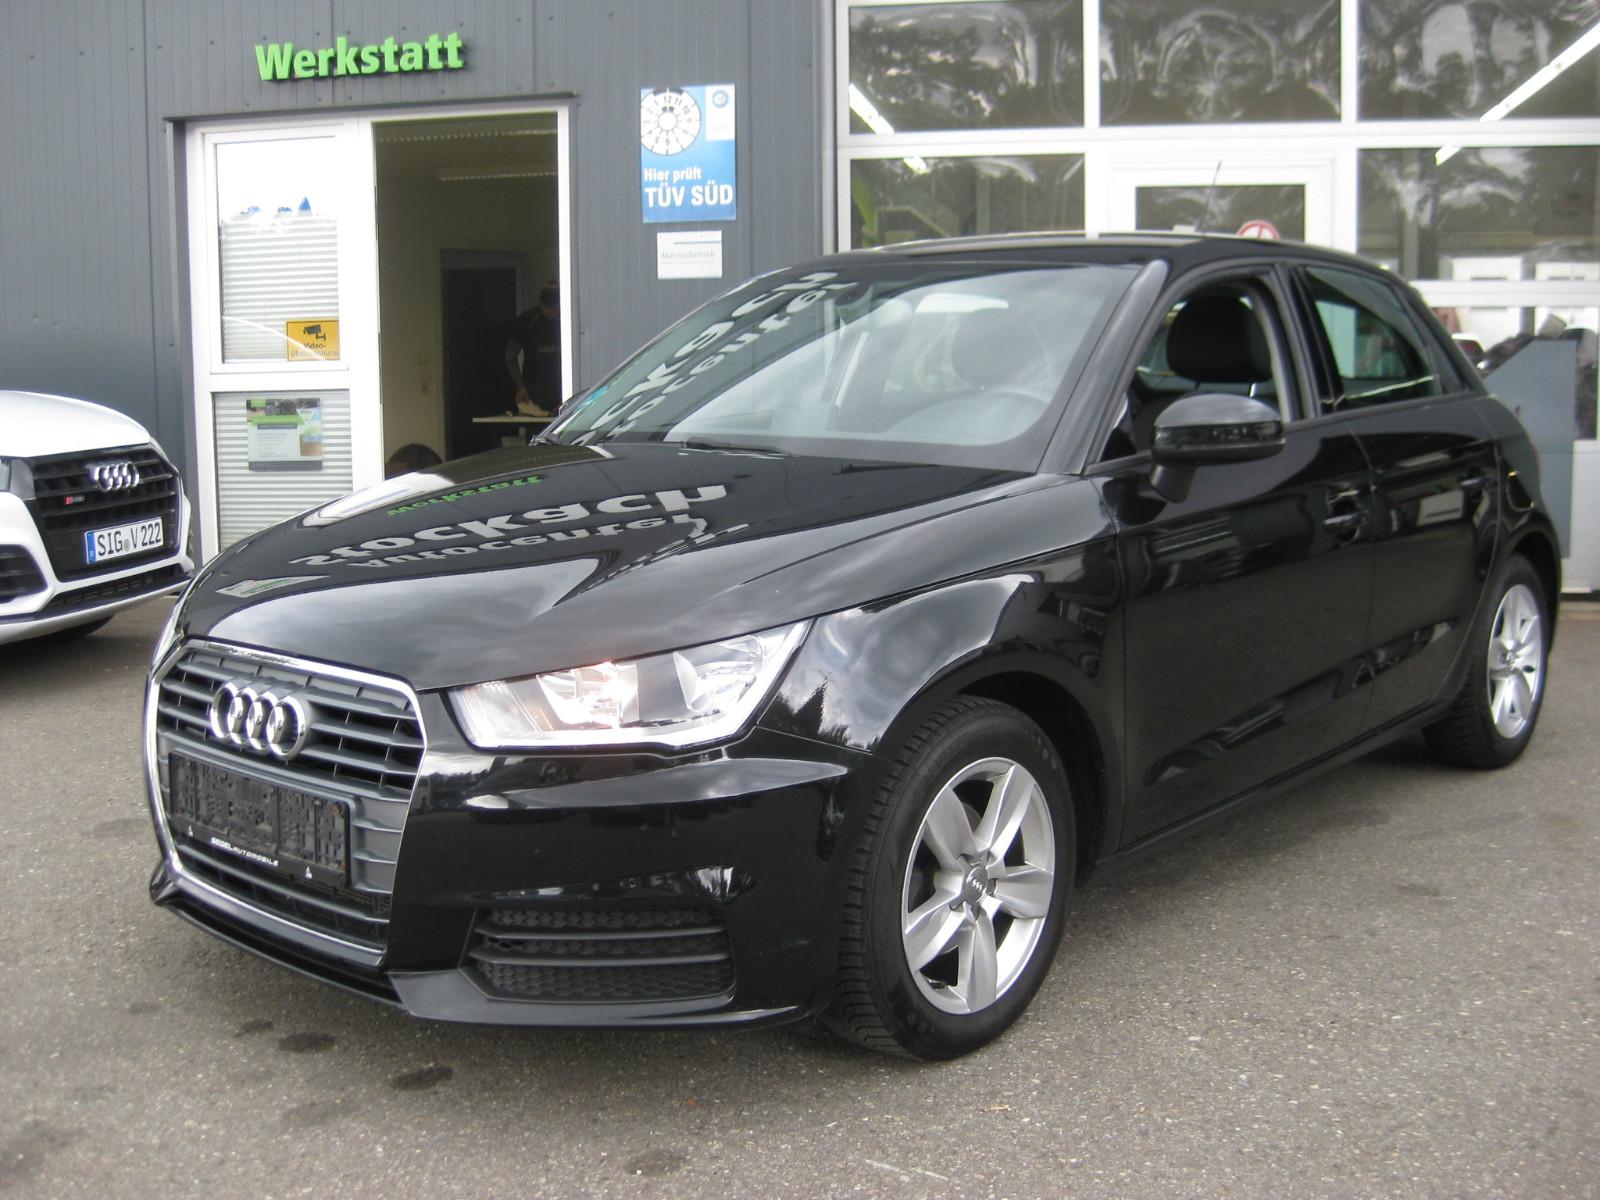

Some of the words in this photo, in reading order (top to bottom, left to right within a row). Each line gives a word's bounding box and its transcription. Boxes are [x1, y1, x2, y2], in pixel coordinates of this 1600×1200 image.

[255, 32, 463, 81] Werkstatt
[644, 168, 670, 181] Hier
[672, 166, 702, 183] prüft
[644, 182, 685, 208] TÜV
[691, 180, 733, 206] SÜD
[98, 531, 122, 556] SIG
[141, 523, 162, 546] 222
